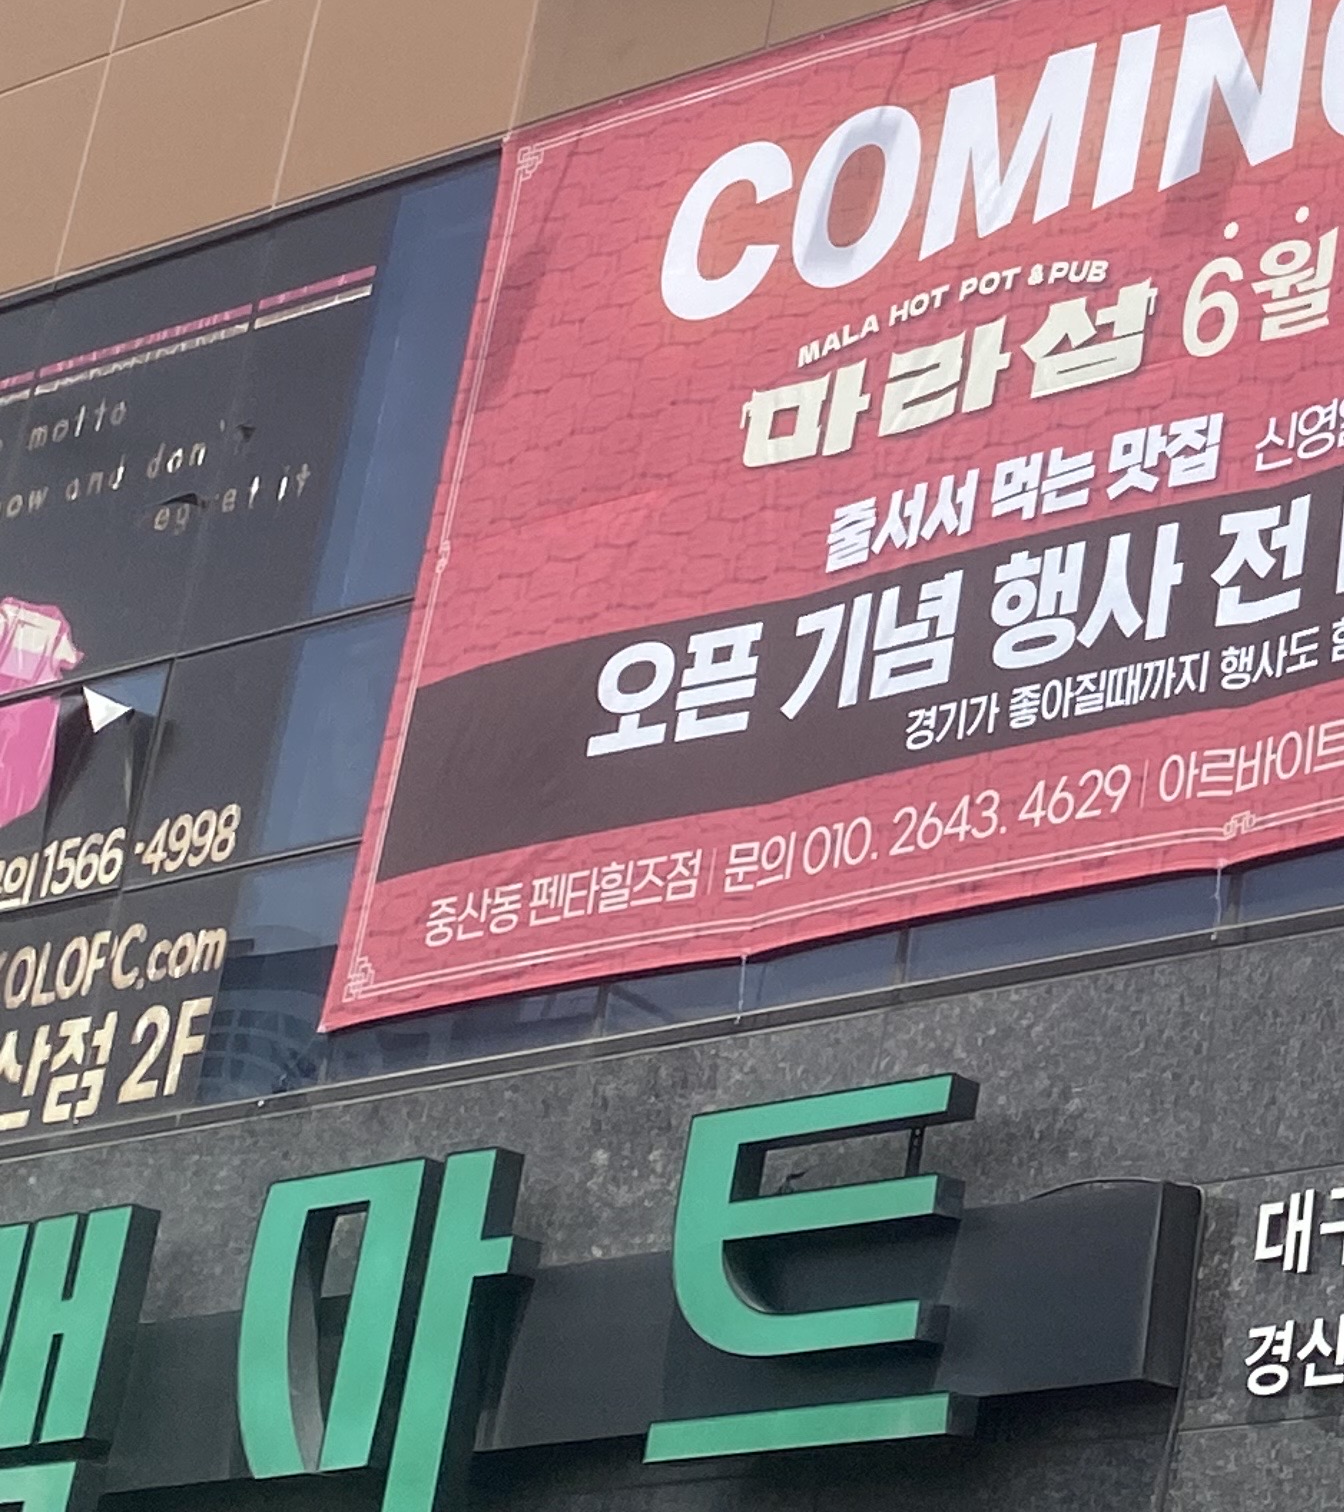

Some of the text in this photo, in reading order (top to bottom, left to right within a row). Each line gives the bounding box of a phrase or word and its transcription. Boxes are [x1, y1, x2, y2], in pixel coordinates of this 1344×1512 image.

[797, 314, 879, 368] MALA
[889, 284, 949, 327] HOT
[959, 266, 1022, 302] POT
[1047, 260, 1109, 284] PUB
[0, 486, 49, 518] ow
[826, 468, 979, 574] 줄서서
[991, 447, 1095, 521] 먹는
[1107, 413, 1224, 501] 맛집
[586, 622, 763, 757] 오픈
[780, 569, 965, 719] 기념
[991, 522, 1183, 670] 행사
[1211, 493, 1312, 627] 전
[906, 692, 1000, 751] 경기가
[1008, 650, 1209, 731] 좋아질때까지
[1220, 626, 1320, 691] 행사도
[425, 883, 521, 948] 중산동
[529, 850, 703, 926] 펜타힐즈점
[724, 831, 796, 889] 문의
[0, 922, 227, 1009] OLOFC.com
[118, 996, 213, 1104] 2F
